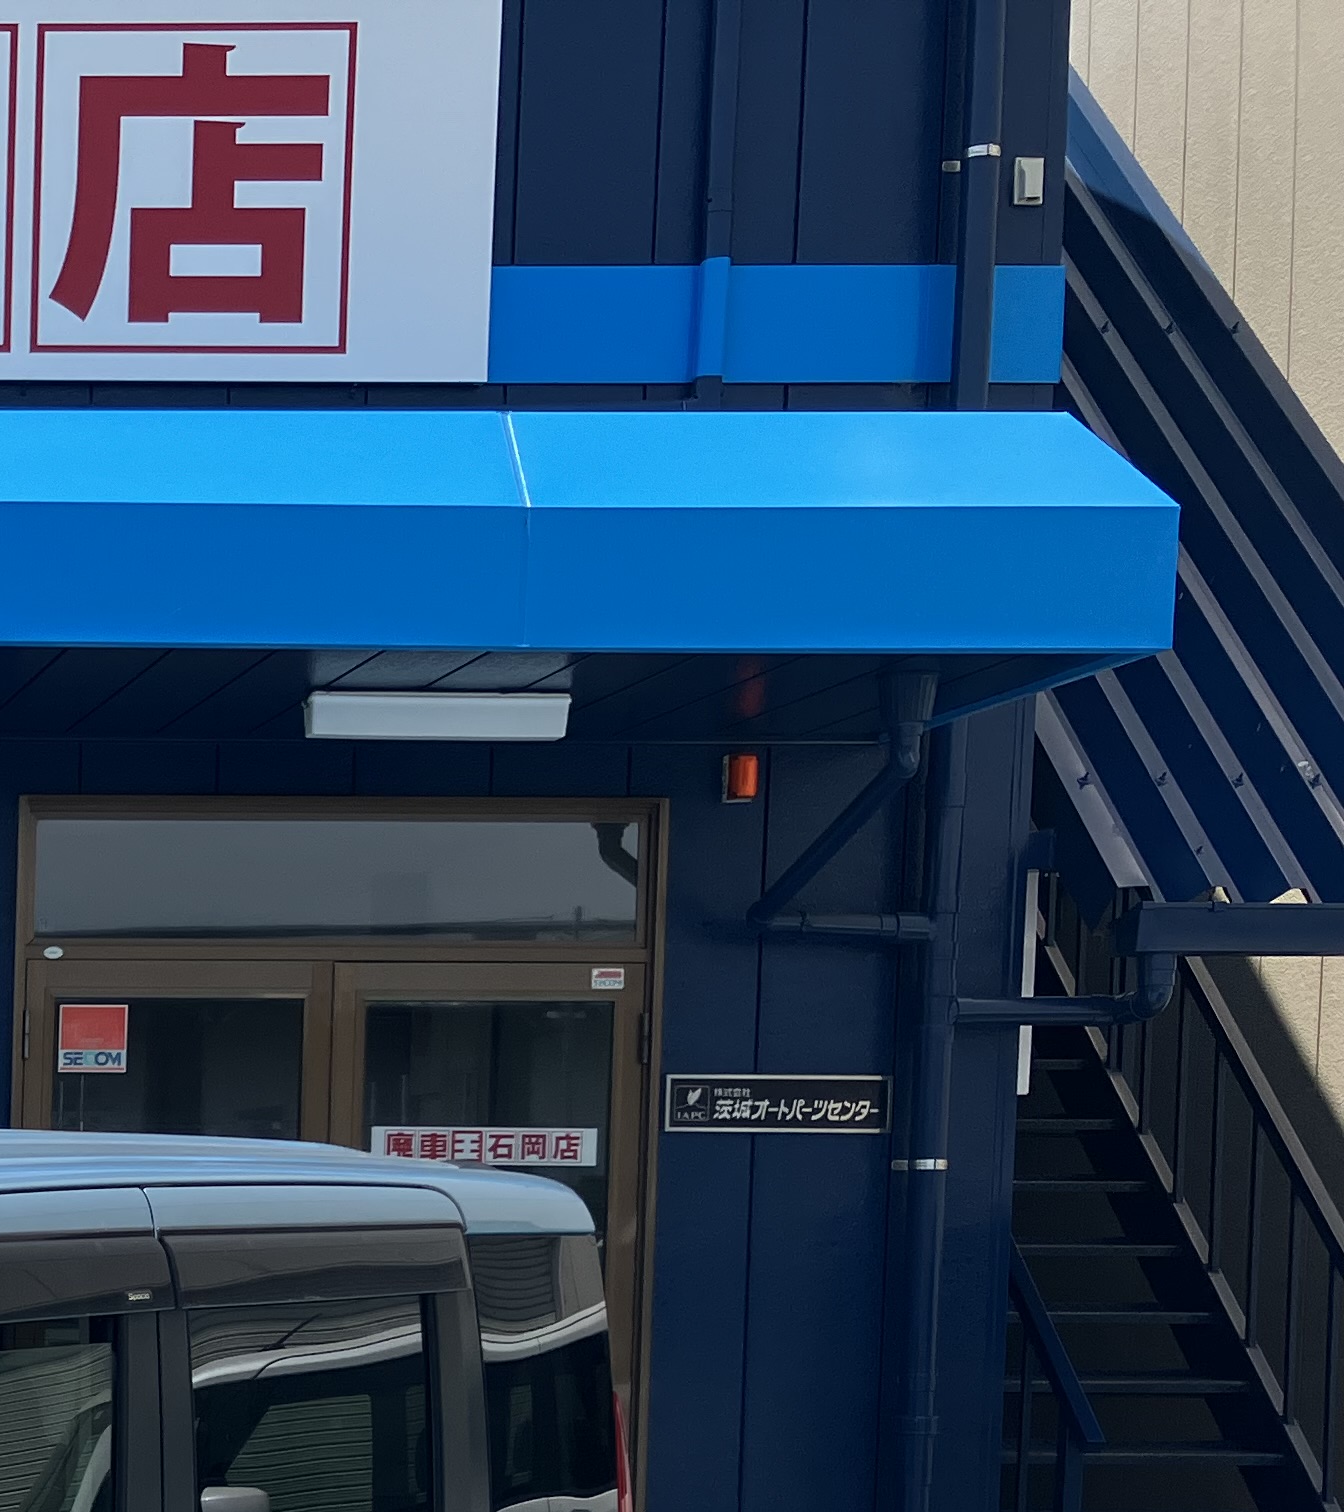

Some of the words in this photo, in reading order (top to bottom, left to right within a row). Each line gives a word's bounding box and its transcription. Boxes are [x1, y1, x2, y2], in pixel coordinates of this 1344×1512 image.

[62, 1051, 122, 1067] SECOM
[712, 1098, 880, 1122] 茨城オートパーツセンター
[385, 1130, 583, 1162] 廃車王石岡店
